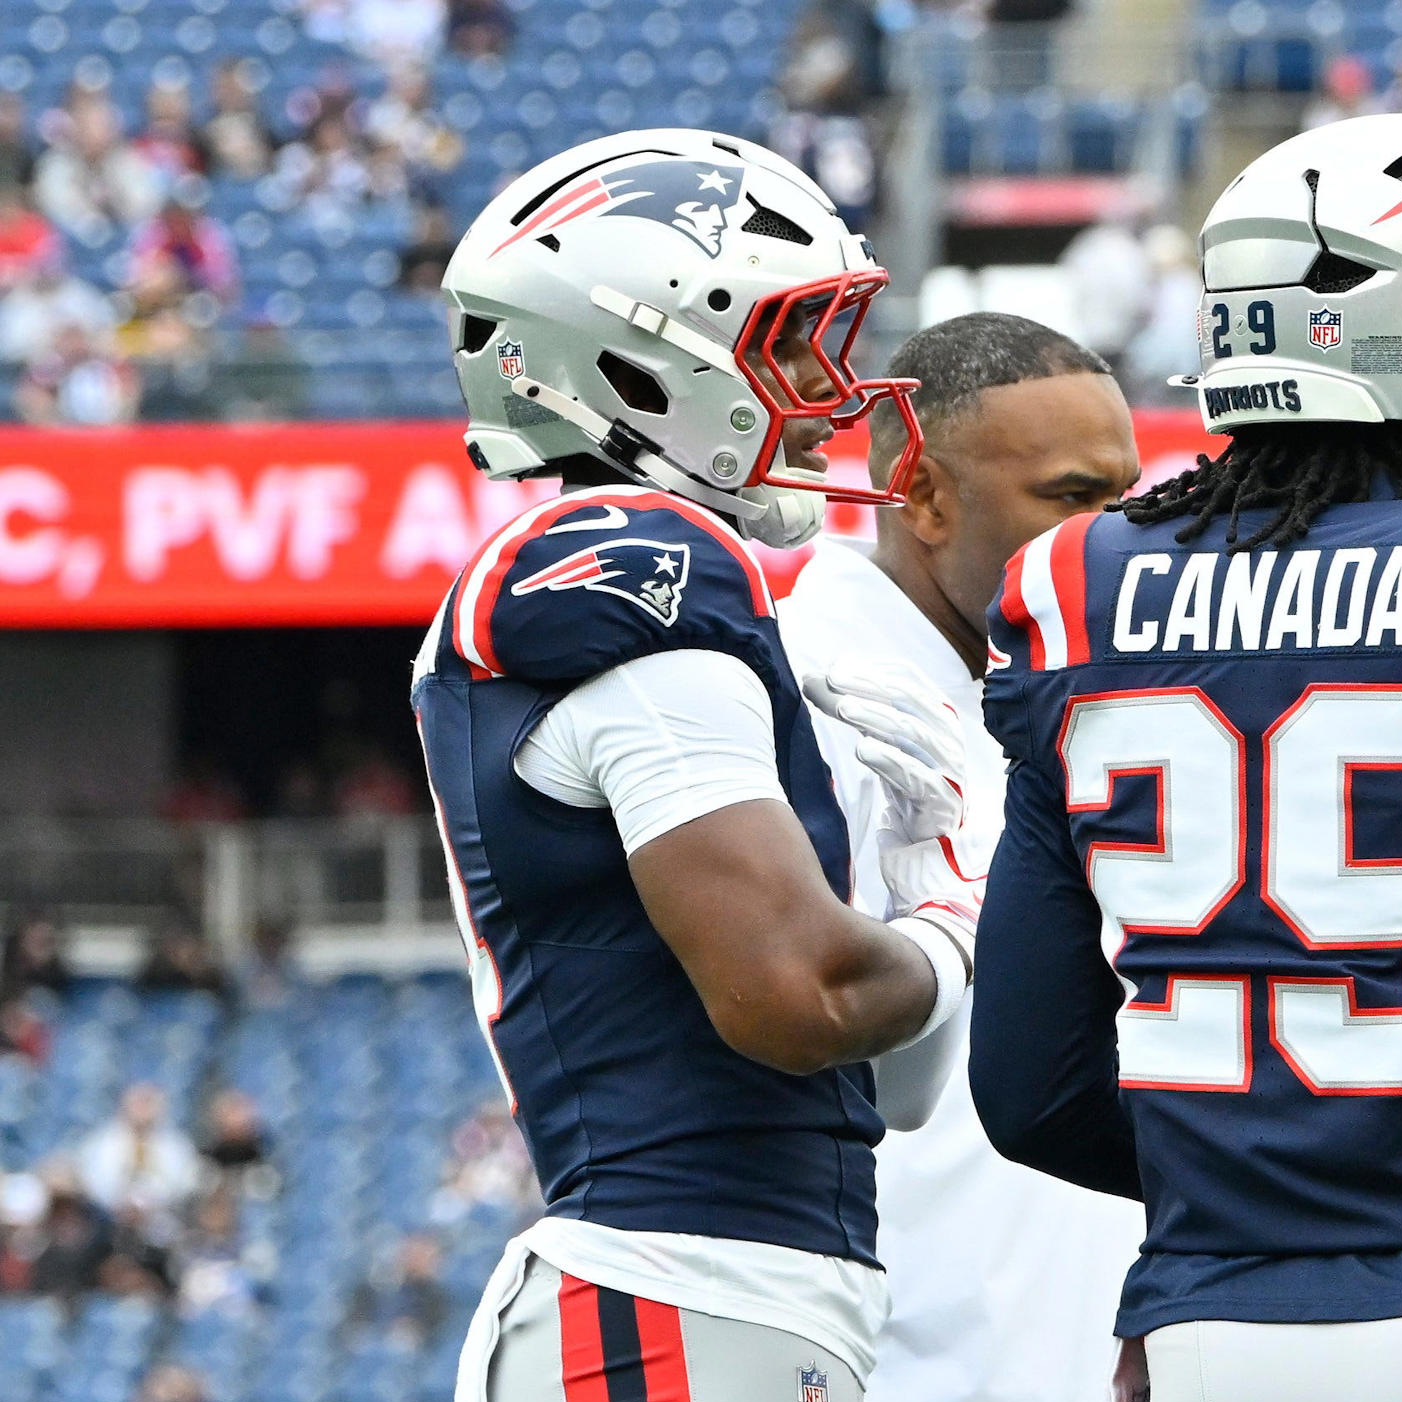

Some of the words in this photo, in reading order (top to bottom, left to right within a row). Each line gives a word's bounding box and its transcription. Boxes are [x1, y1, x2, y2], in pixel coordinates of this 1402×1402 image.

[1211, 300, 1276, 359] 29
[1312, 326, 1338, 345] NFL
[502, 358, 522, 376] NFL
[1204, 379, 1302, 419] PATRIOTS
[120, 462, 370, 584] PVF
